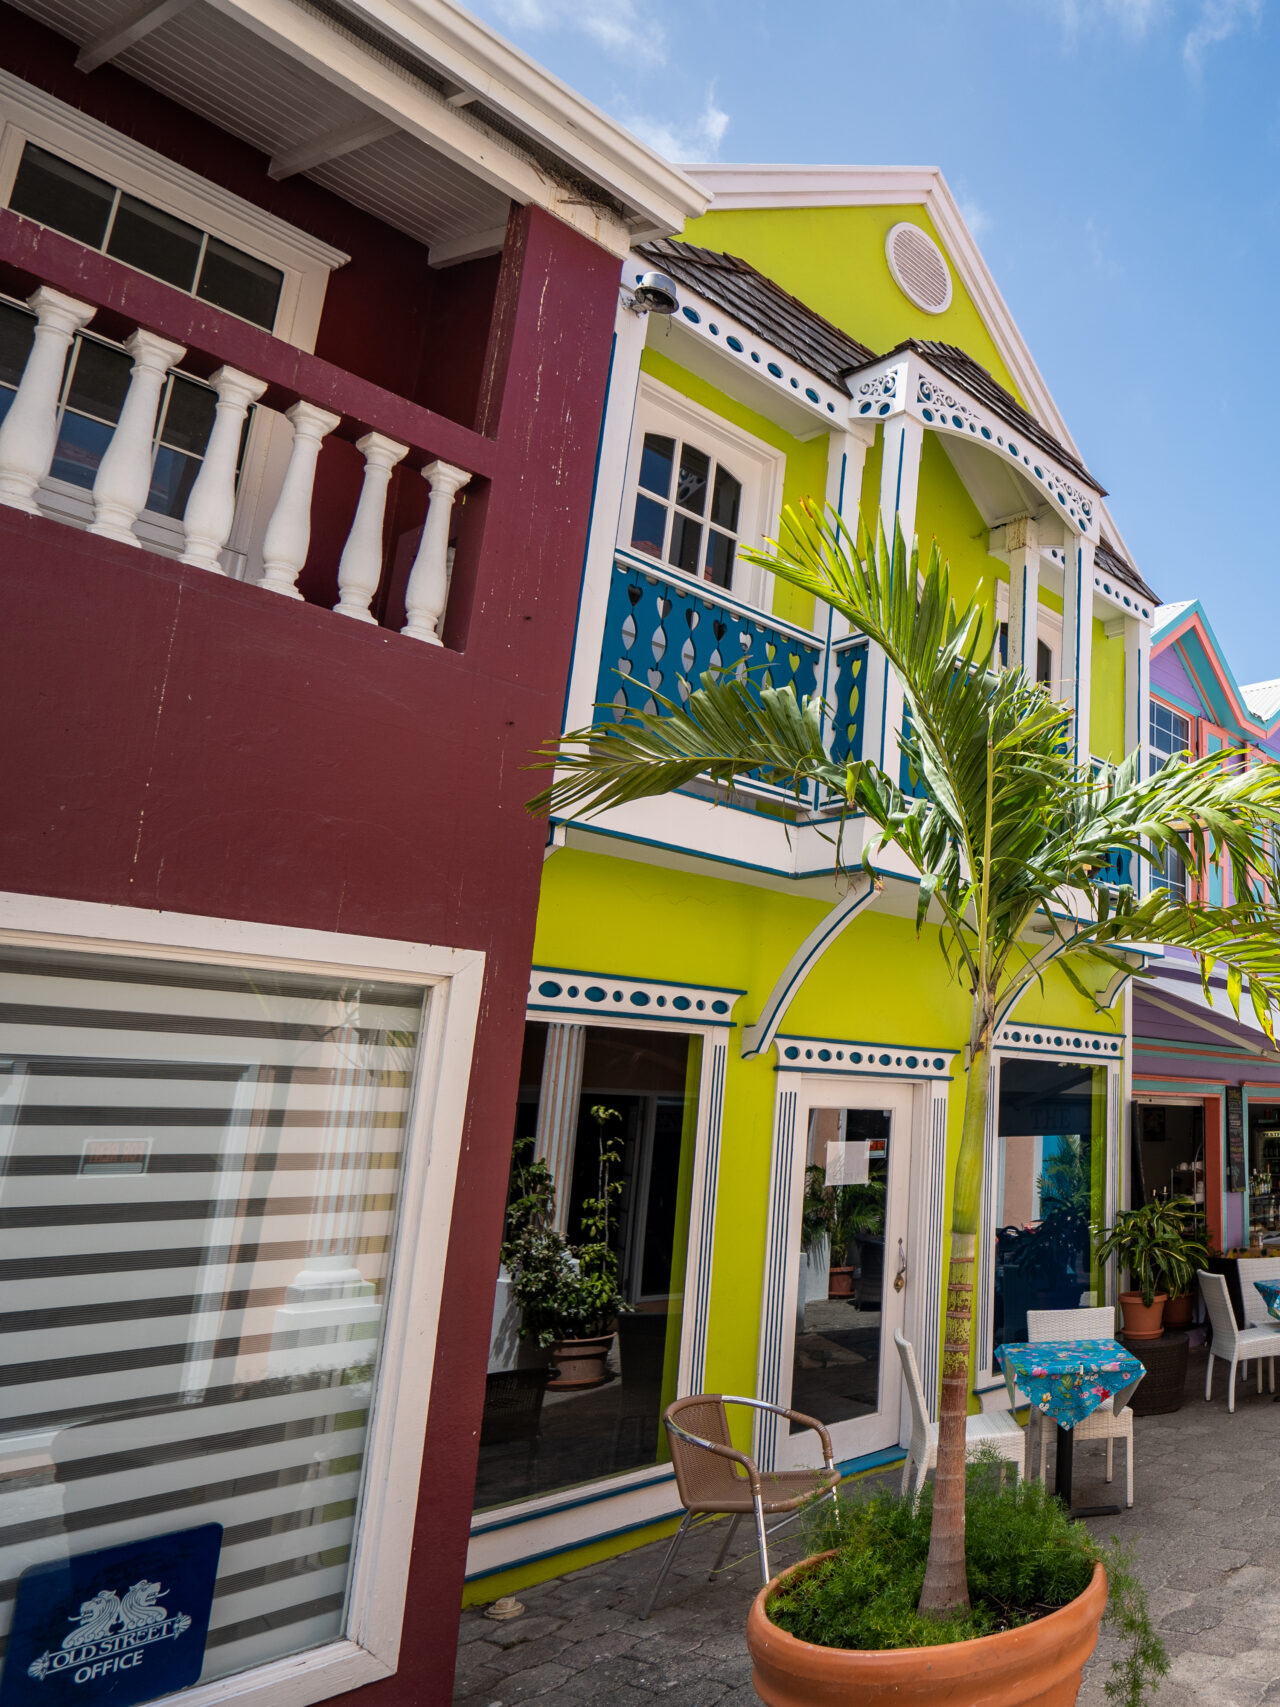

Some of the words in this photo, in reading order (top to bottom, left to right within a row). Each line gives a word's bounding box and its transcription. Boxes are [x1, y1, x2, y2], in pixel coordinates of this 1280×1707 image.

[52, 1645, 97, 1669] OLD
[99, 1621, 172, 1655] STREET
[74, 1650, 144, 1683] OFFICE
